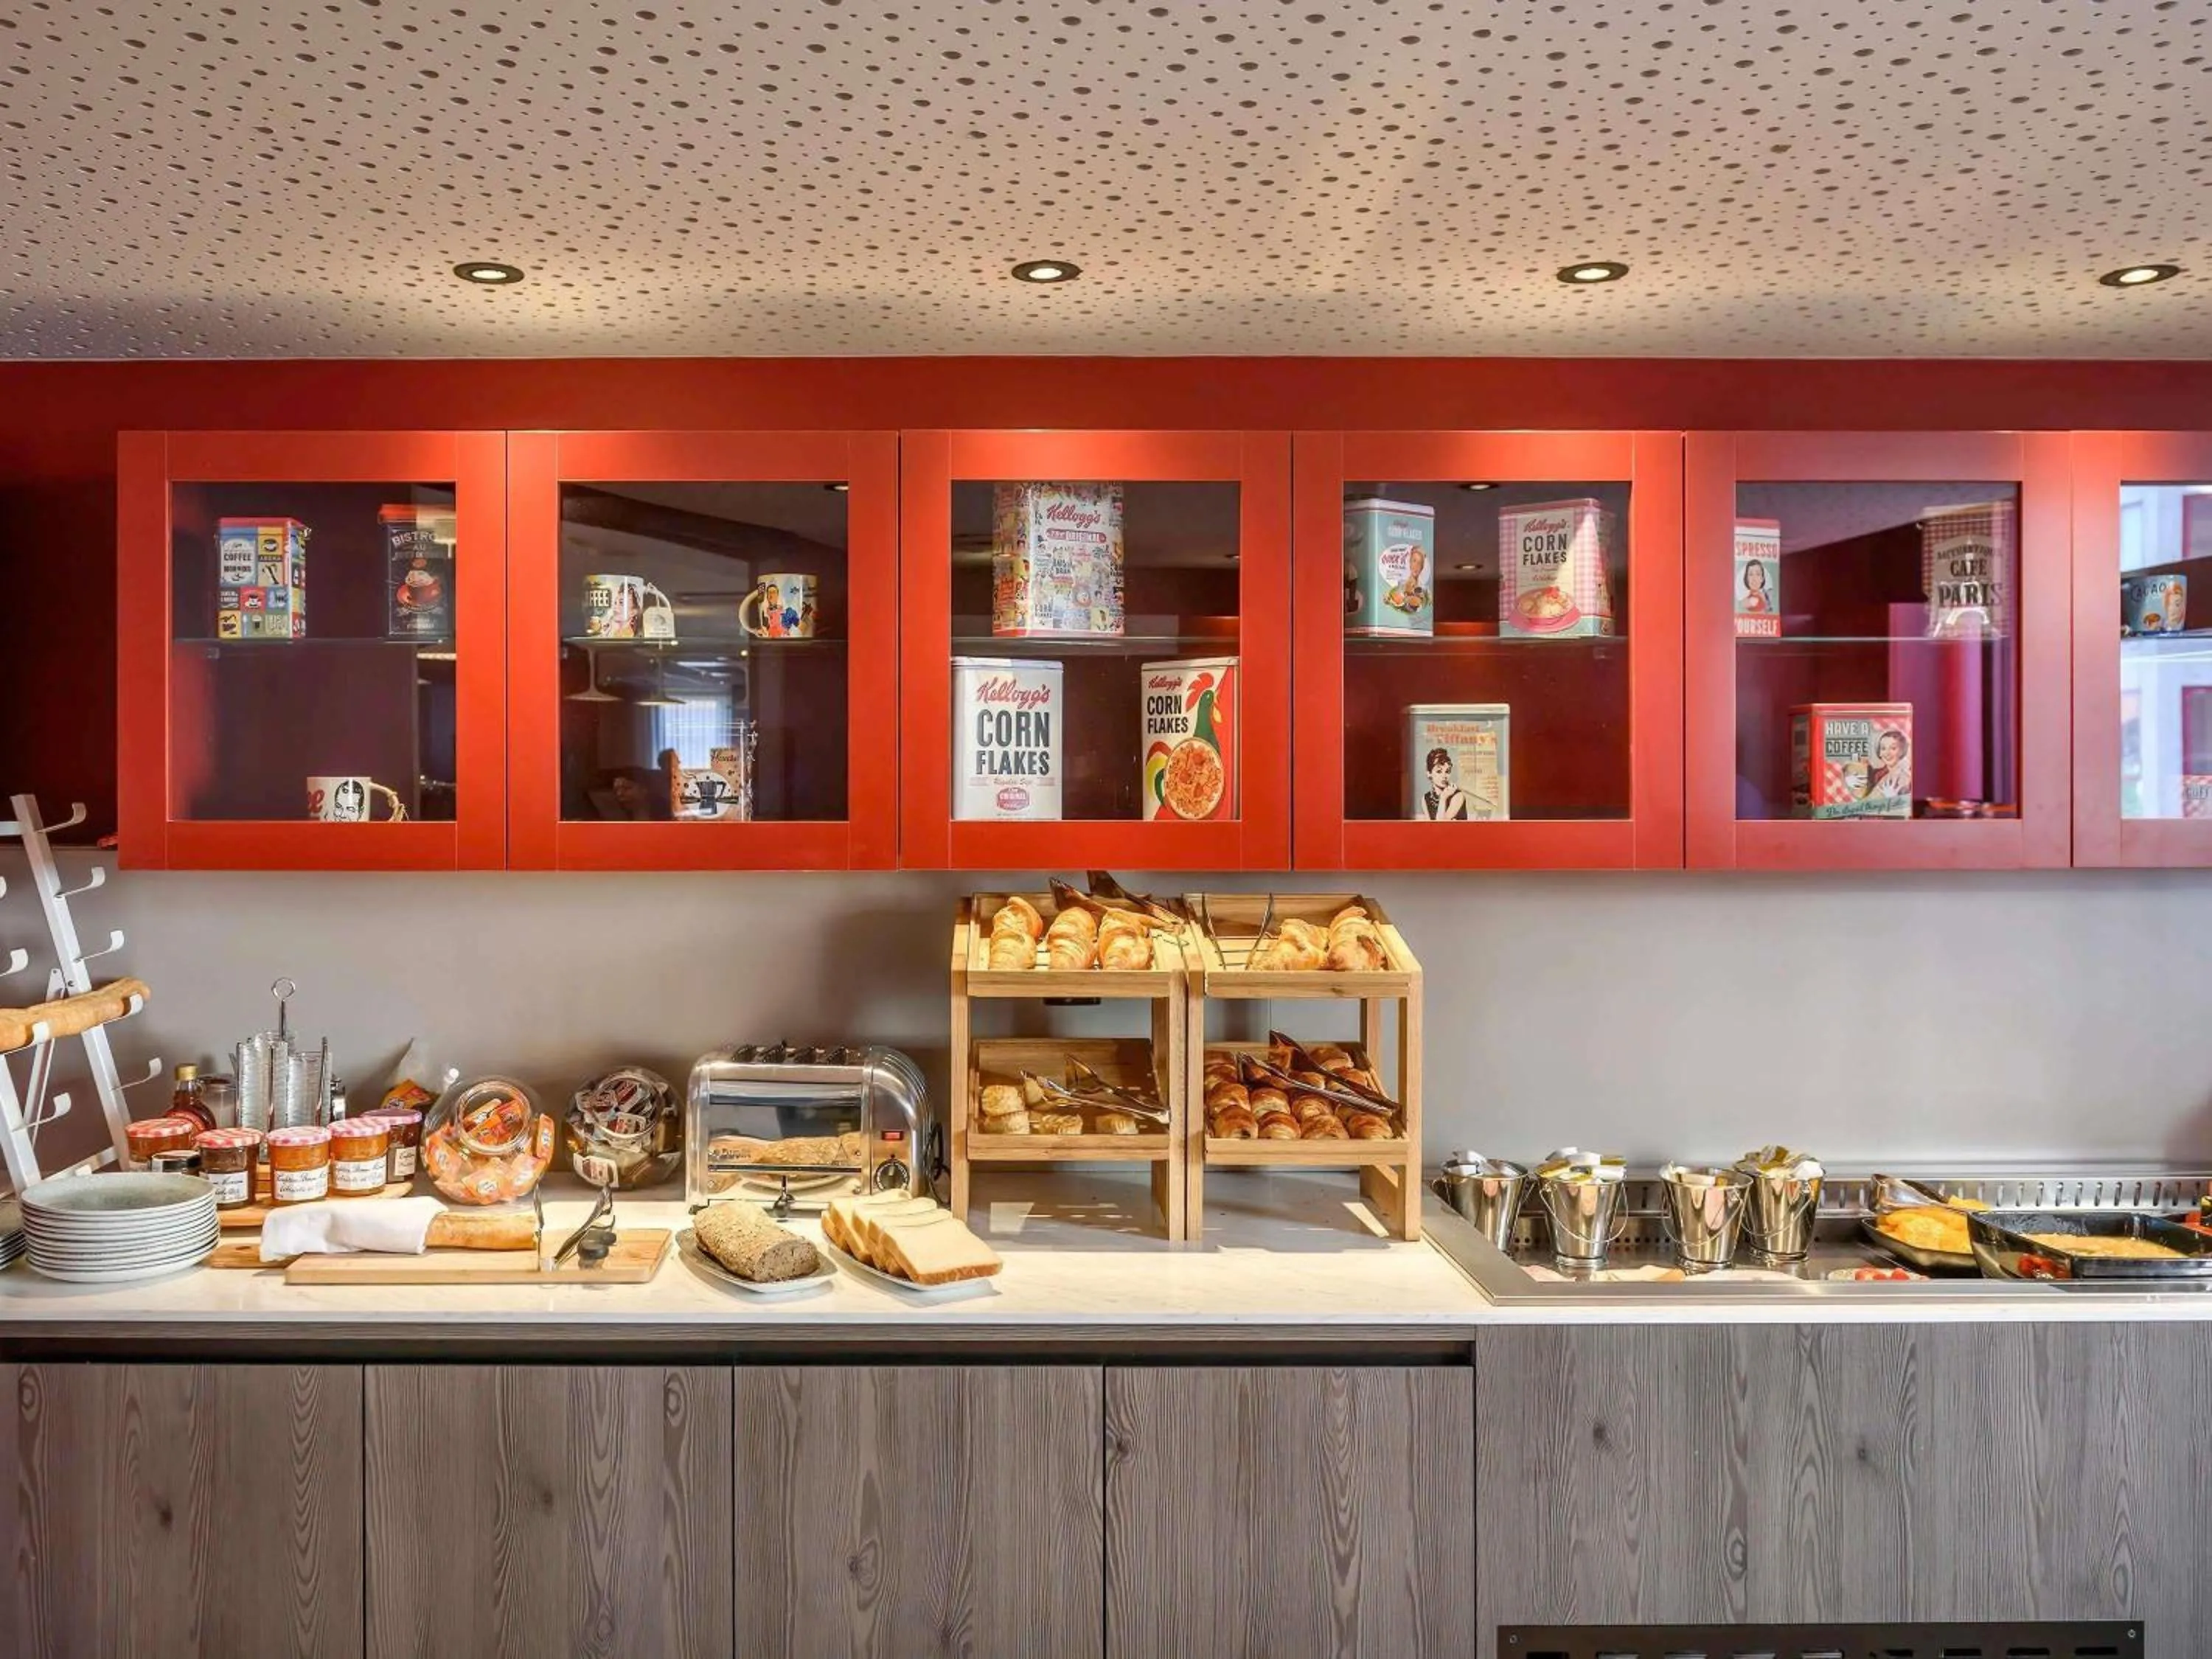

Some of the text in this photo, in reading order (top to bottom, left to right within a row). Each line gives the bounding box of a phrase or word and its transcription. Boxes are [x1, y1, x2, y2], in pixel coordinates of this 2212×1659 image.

[1047, 503, 1101, 528] Kellogg's
[1523, 518, 1568, 533] Kellogg's
[1523, 533, 1568, 552] CORN
[1736, 542, 1778, 558] SPRESSO
[224, 553, 251, 561] COFFEE
[1523, 552, 1568, 566] FLAKES
[1938, 582, 2003, 606] PARIS
[1148, 675, 1183, 691] Kellogg's
[976, 677, 1050, 709] Kellogg's
[1147, 695, 1181, 715] CORN
[976, 709, 1049, 748] CORN
[1147, 717, 1189, 734] FLAKES
[1826, 721, 1870, 736] HAVE A
[1826, 741, 1869, 754] COFFEE
[975, 751, 1050, 776] FLAKES
